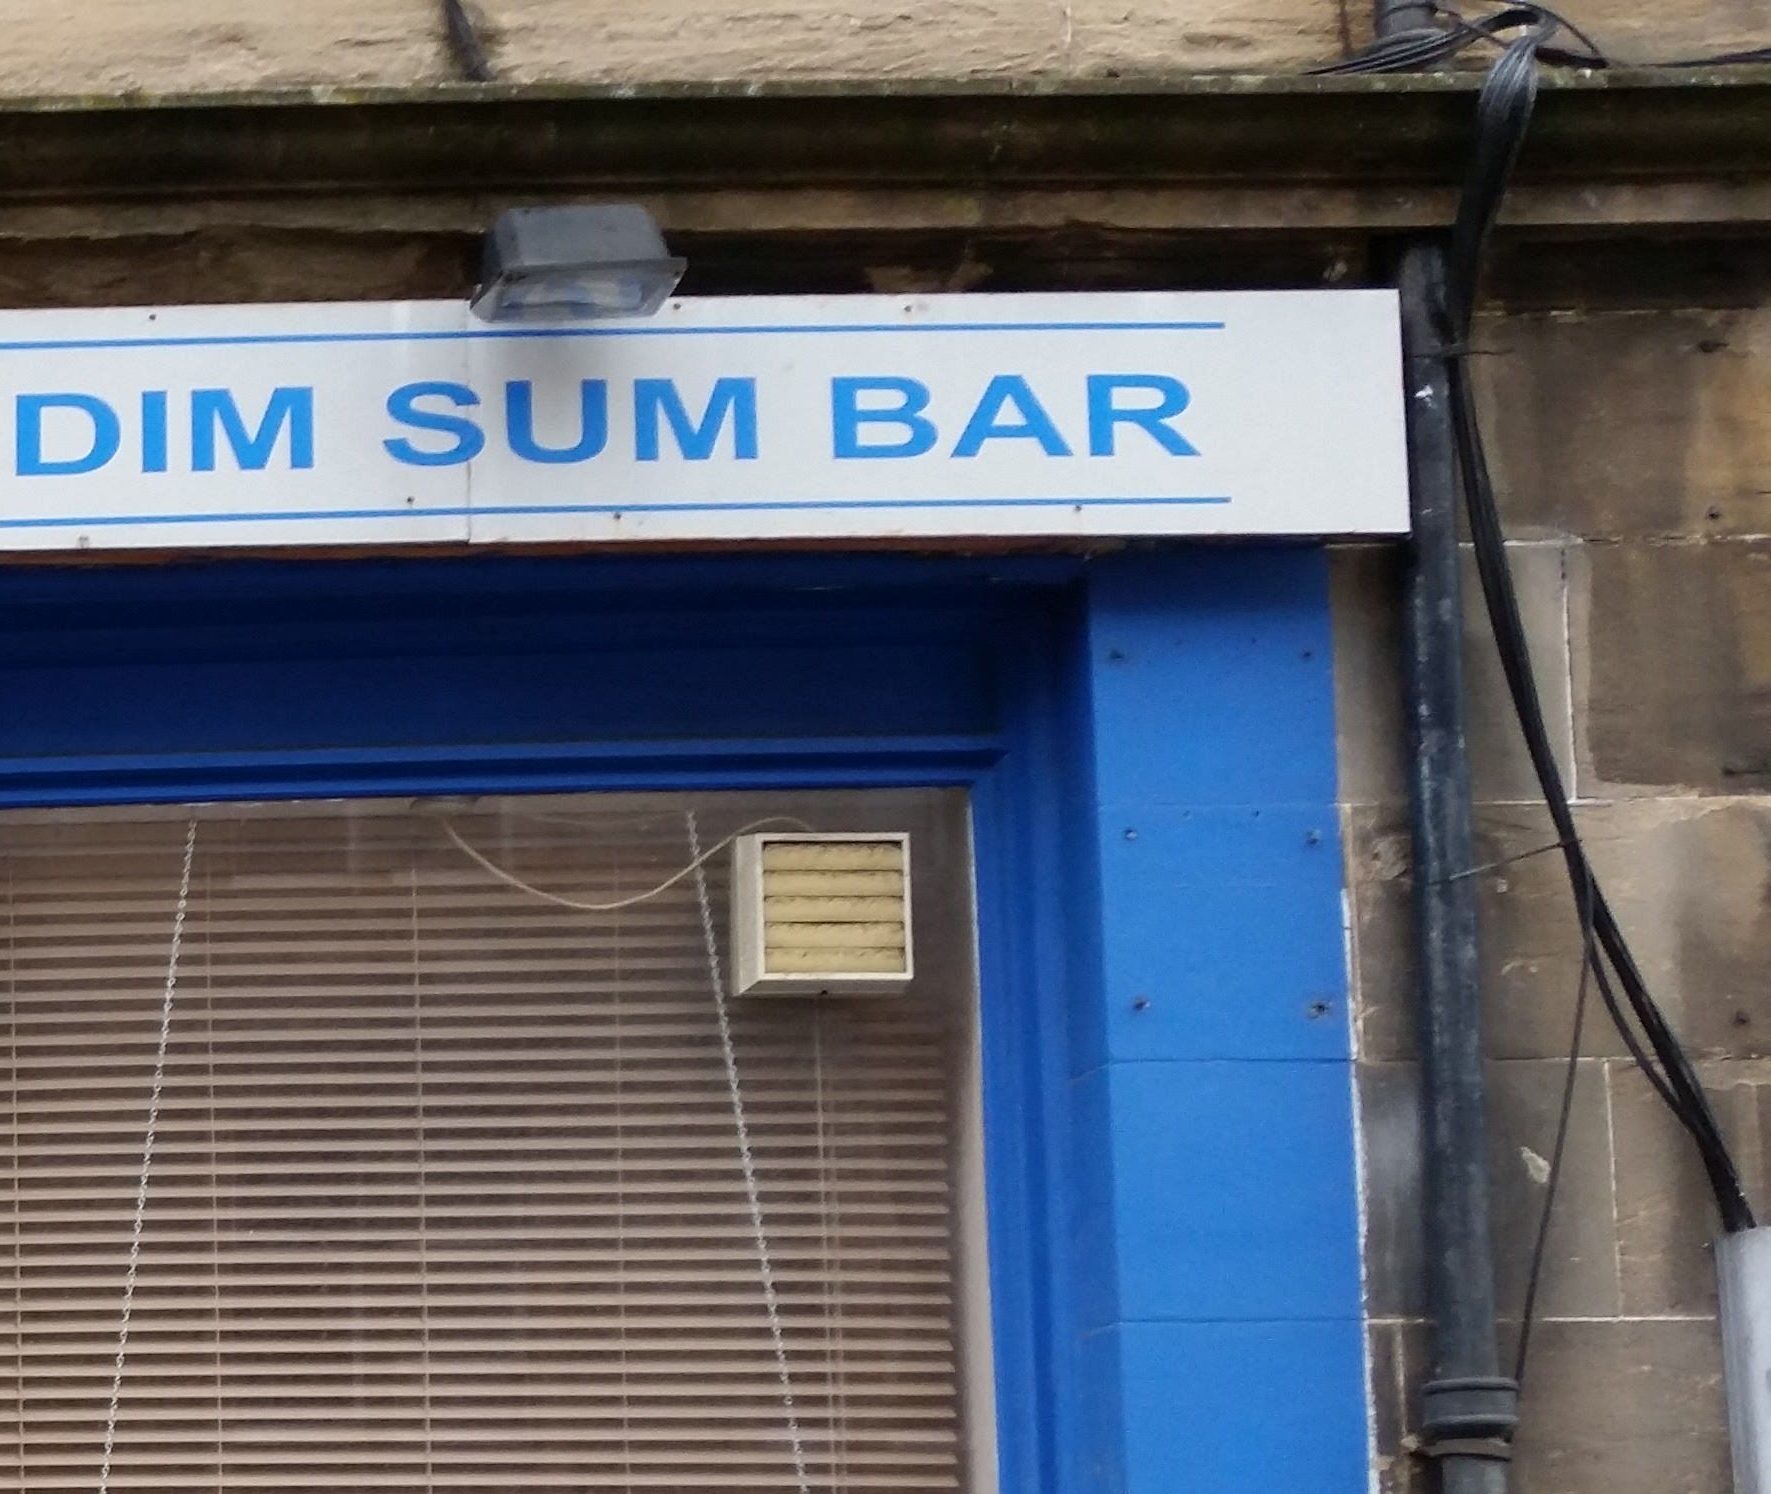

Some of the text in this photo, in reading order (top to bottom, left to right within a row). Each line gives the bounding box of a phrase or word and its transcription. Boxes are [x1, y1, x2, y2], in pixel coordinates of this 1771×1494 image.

[15, 373, 1196, 477] DIM SUM BAR
